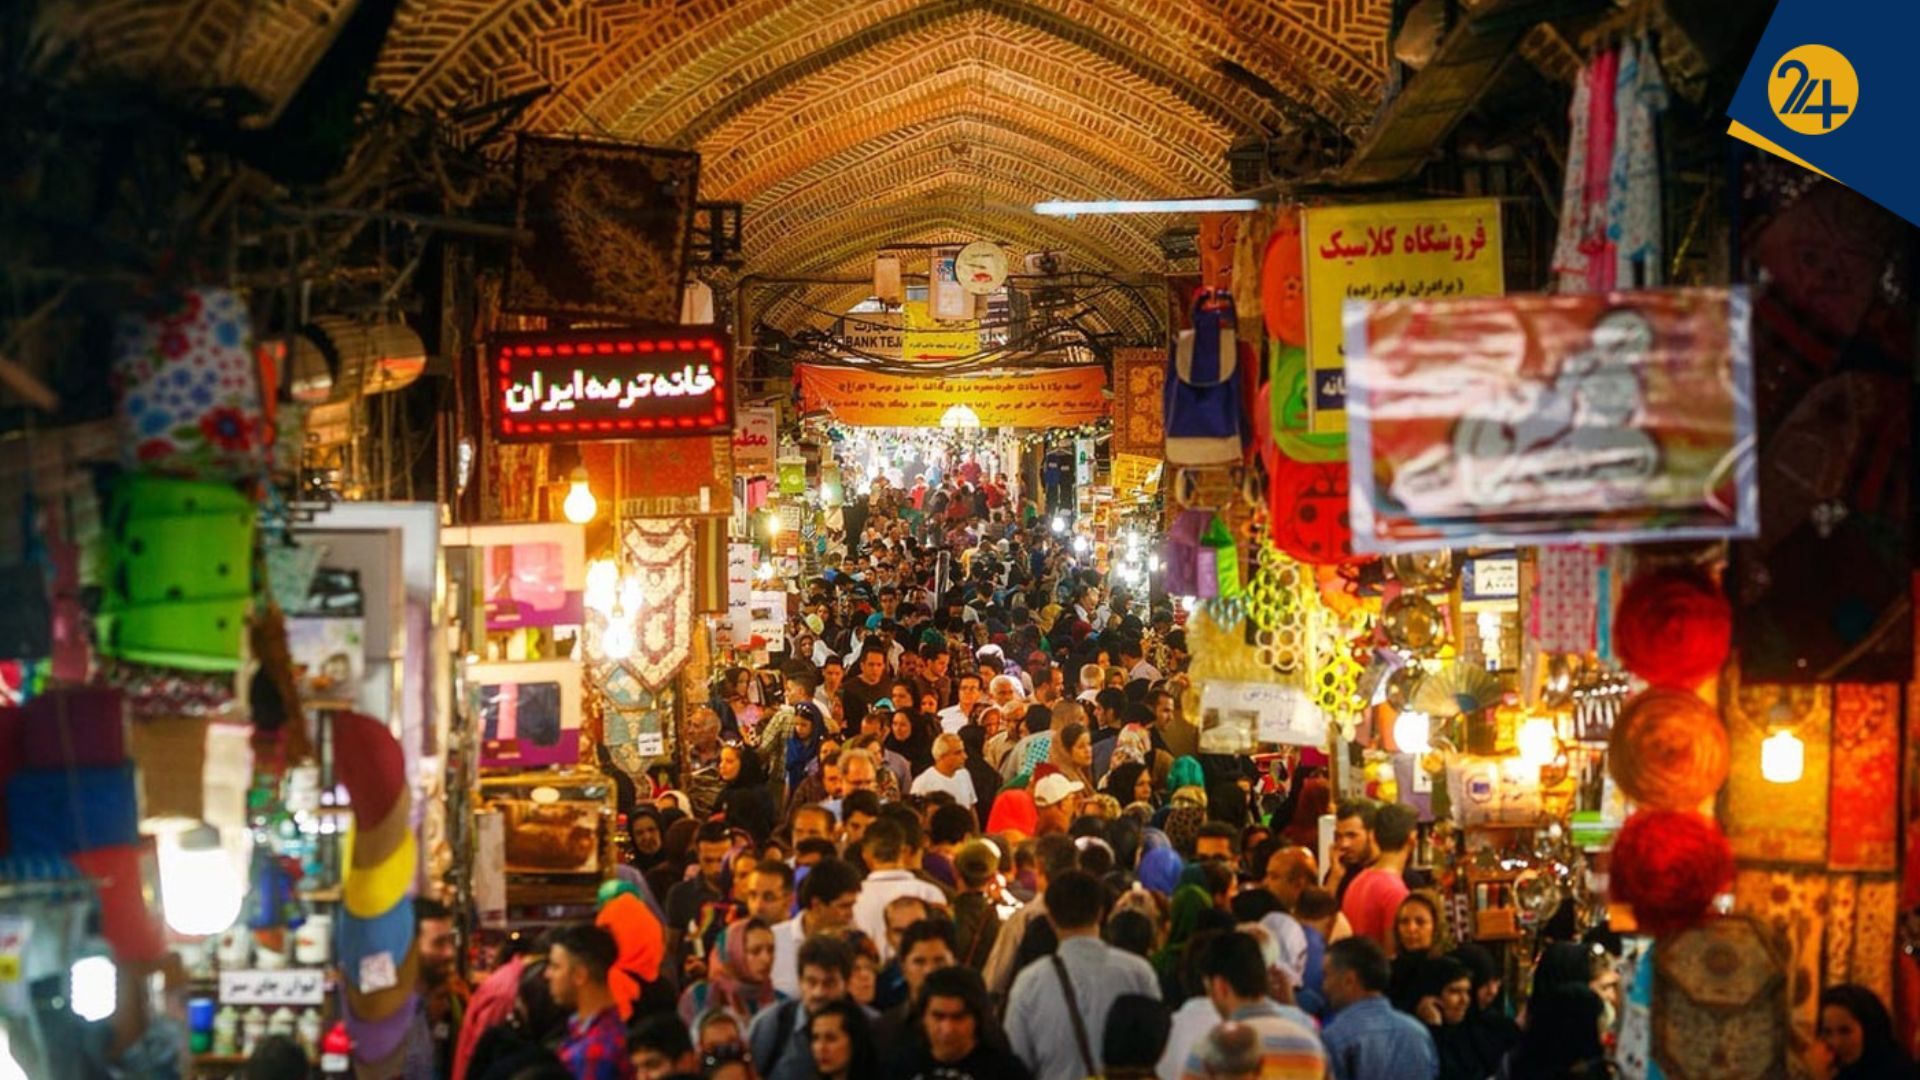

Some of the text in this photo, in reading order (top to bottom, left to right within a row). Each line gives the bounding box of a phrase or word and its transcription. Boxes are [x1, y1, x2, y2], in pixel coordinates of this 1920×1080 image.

[1319, 217, 1487, 266] فروشگاه کلاسیک
[846, 336, 903, 348] BANK TEJ
[504, 364, 716, 412] خانه ترمه ایران
[1321, 375, 1346, 397] انه
